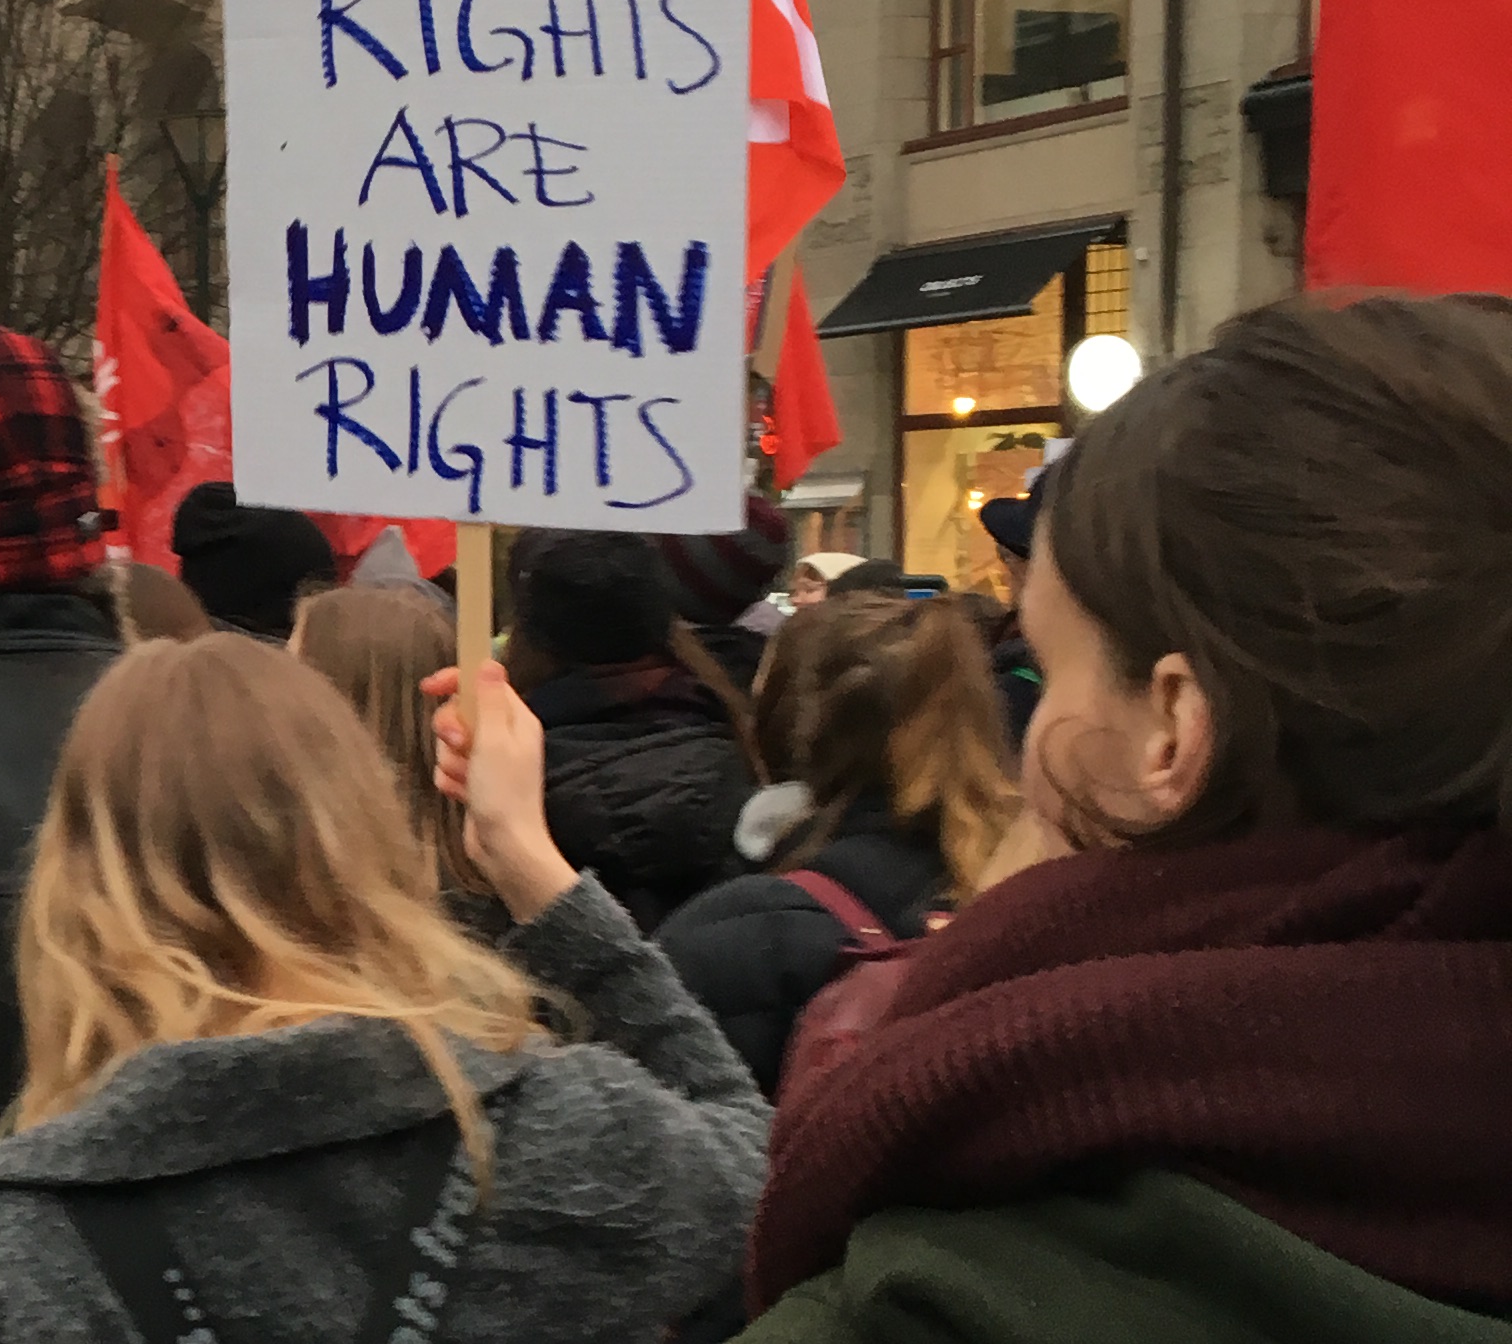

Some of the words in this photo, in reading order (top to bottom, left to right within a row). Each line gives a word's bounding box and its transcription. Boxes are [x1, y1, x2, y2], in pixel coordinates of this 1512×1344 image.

[359, 106, 594, 218] ARE
[287, 216, 708, 357] HUMAN
[294, 356, 694, 514] RIGHTS
